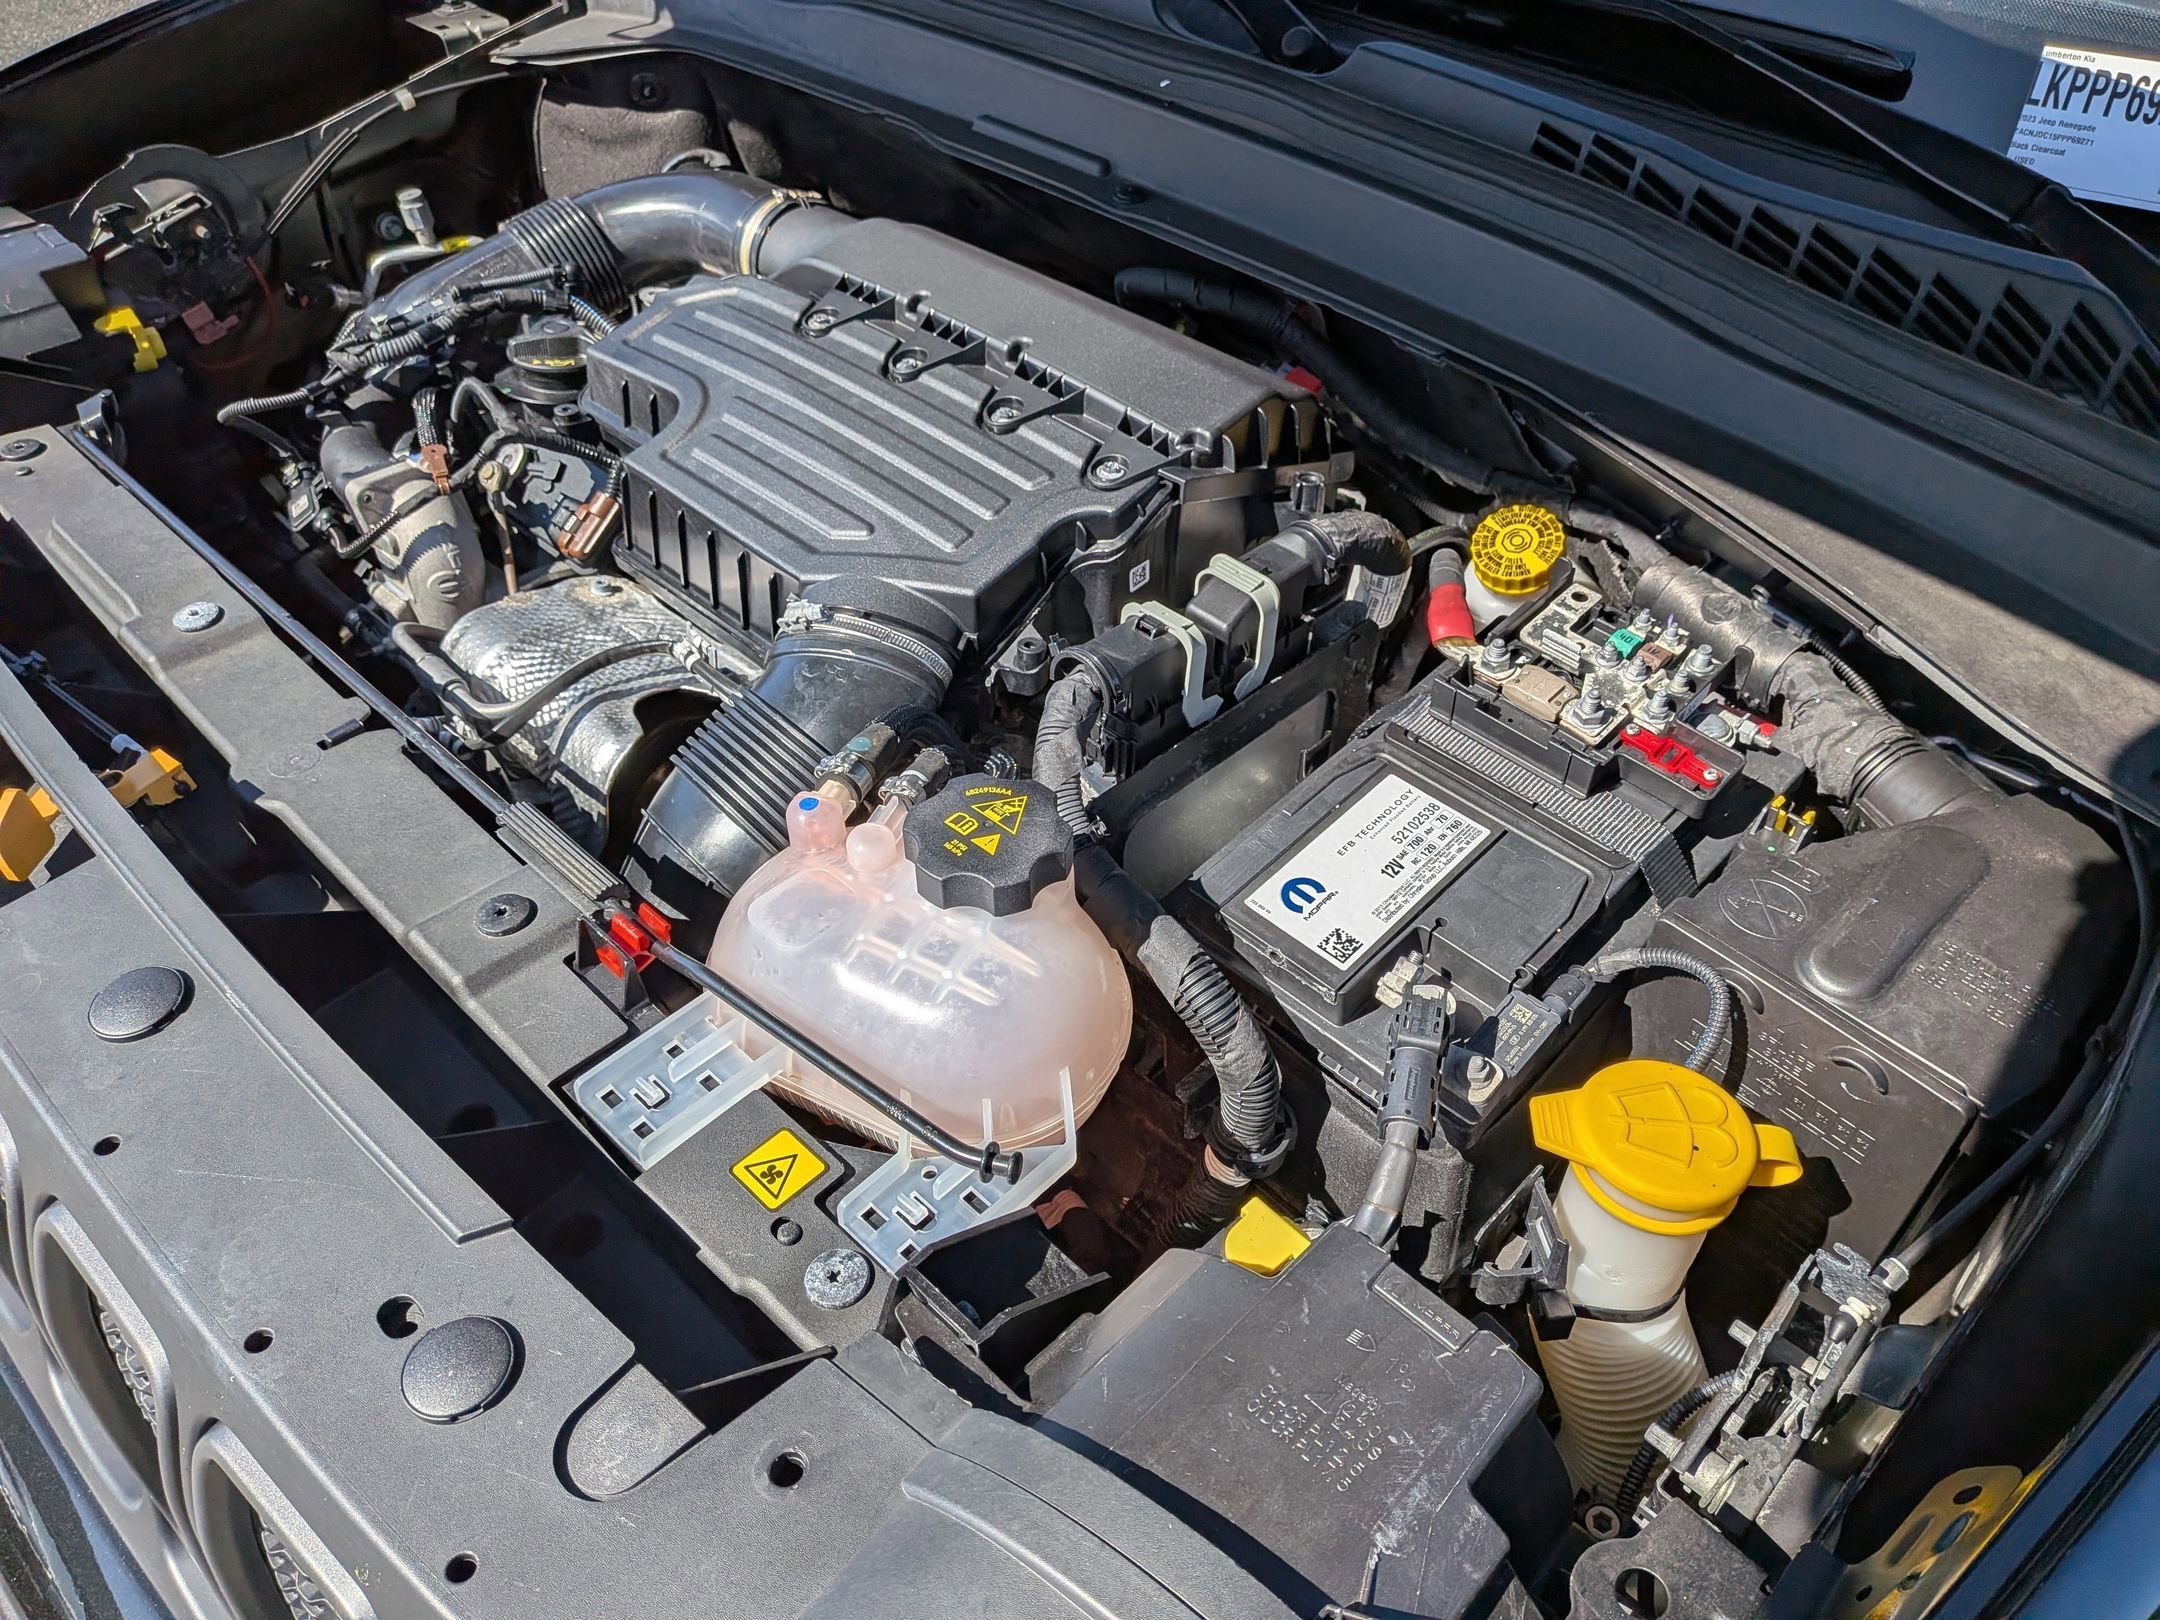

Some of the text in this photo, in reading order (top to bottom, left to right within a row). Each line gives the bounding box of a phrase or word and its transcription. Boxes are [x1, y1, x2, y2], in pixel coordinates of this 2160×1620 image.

[2042, 51, 2096, 63] umberton Kia
[2026, 60, 2160, 126] LKPPP69
[2039, 117, 2057, 127] Jeep
[2058, 120, 2097, 133] Renegade
[2031, 144, 2066, 156] Clearcoat
[1620, 632, 1634, 644] 40
[1336, 841, 1356, 857] EFB
[1356, 788, 1414, 841] TECHNOLOGY
[1391, 799, 1439, 846] 52102538
[1411, 818, 1462, 865] RC 120 EN 760
[1380, 856, 1404, 881] 12V
[1396, 848, 1408, 861] SAE
[1407, 834, 1424, 851] 700
[1435, 812, 1448, 825] 70
